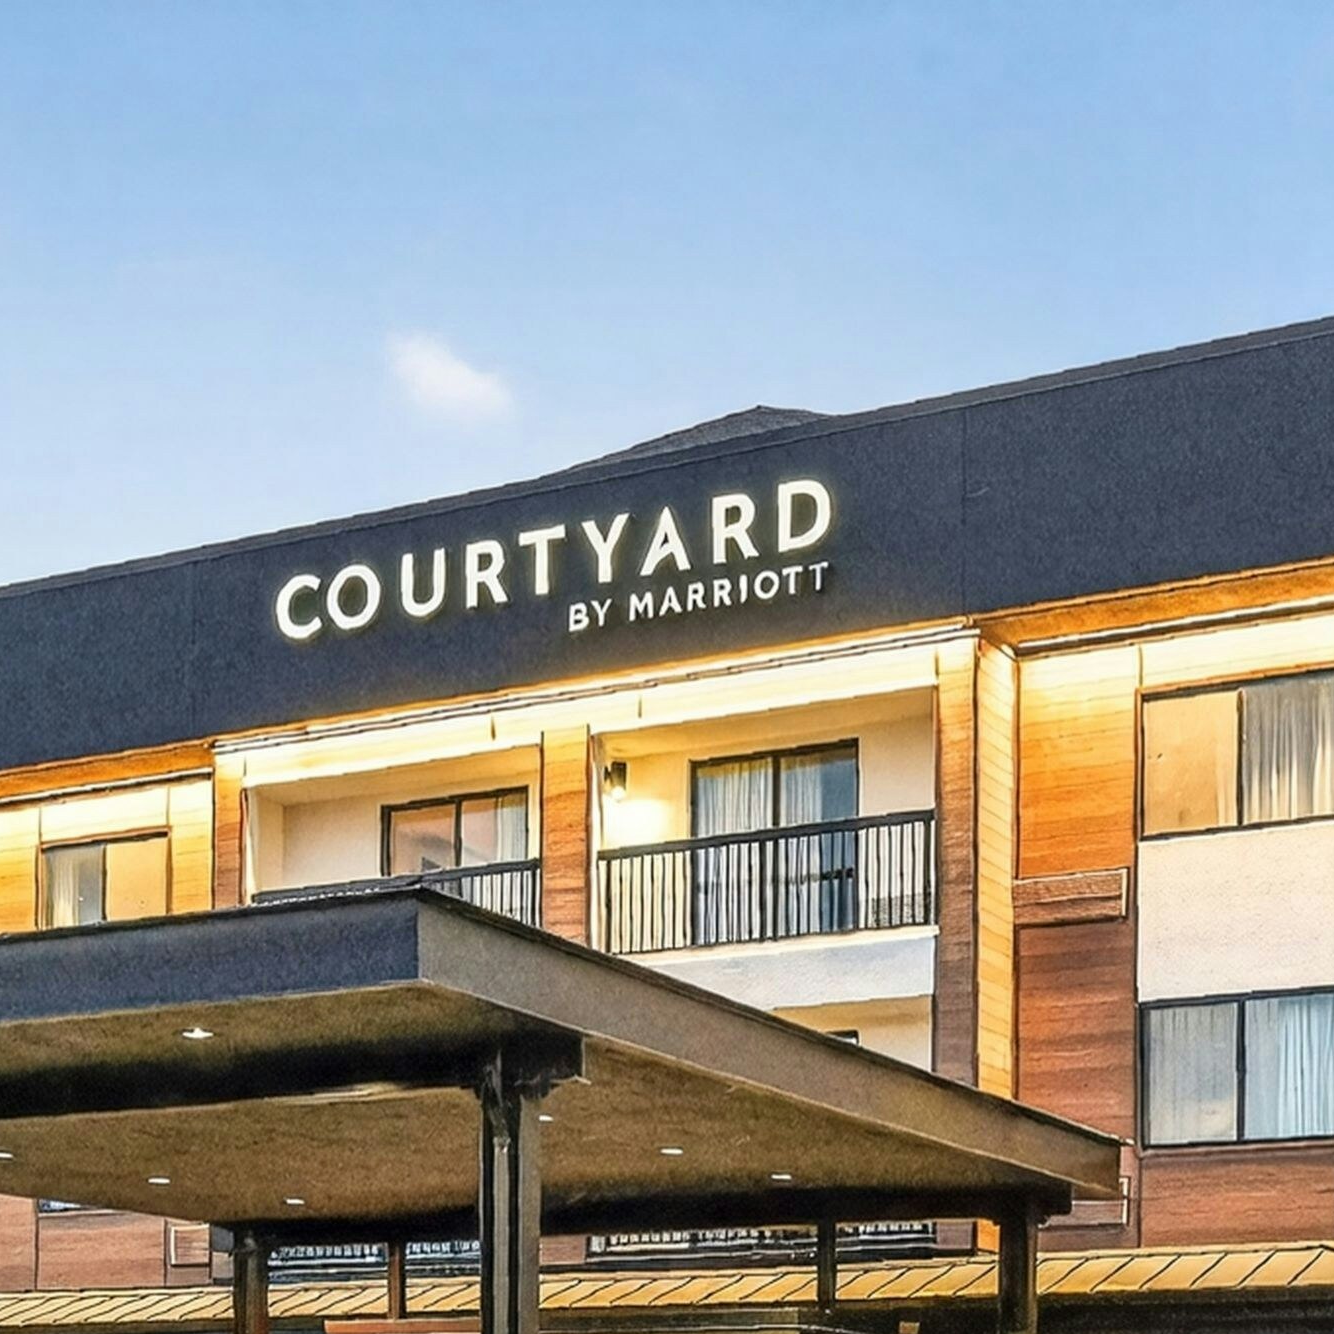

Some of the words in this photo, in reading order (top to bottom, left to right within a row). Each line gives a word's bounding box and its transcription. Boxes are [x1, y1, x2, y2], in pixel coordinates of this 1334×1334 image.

[275, 479, 832, 639] COURTYARD
[568, 598, 613, 632] BY
[628, 561, 829, 622] MARRIOTT
